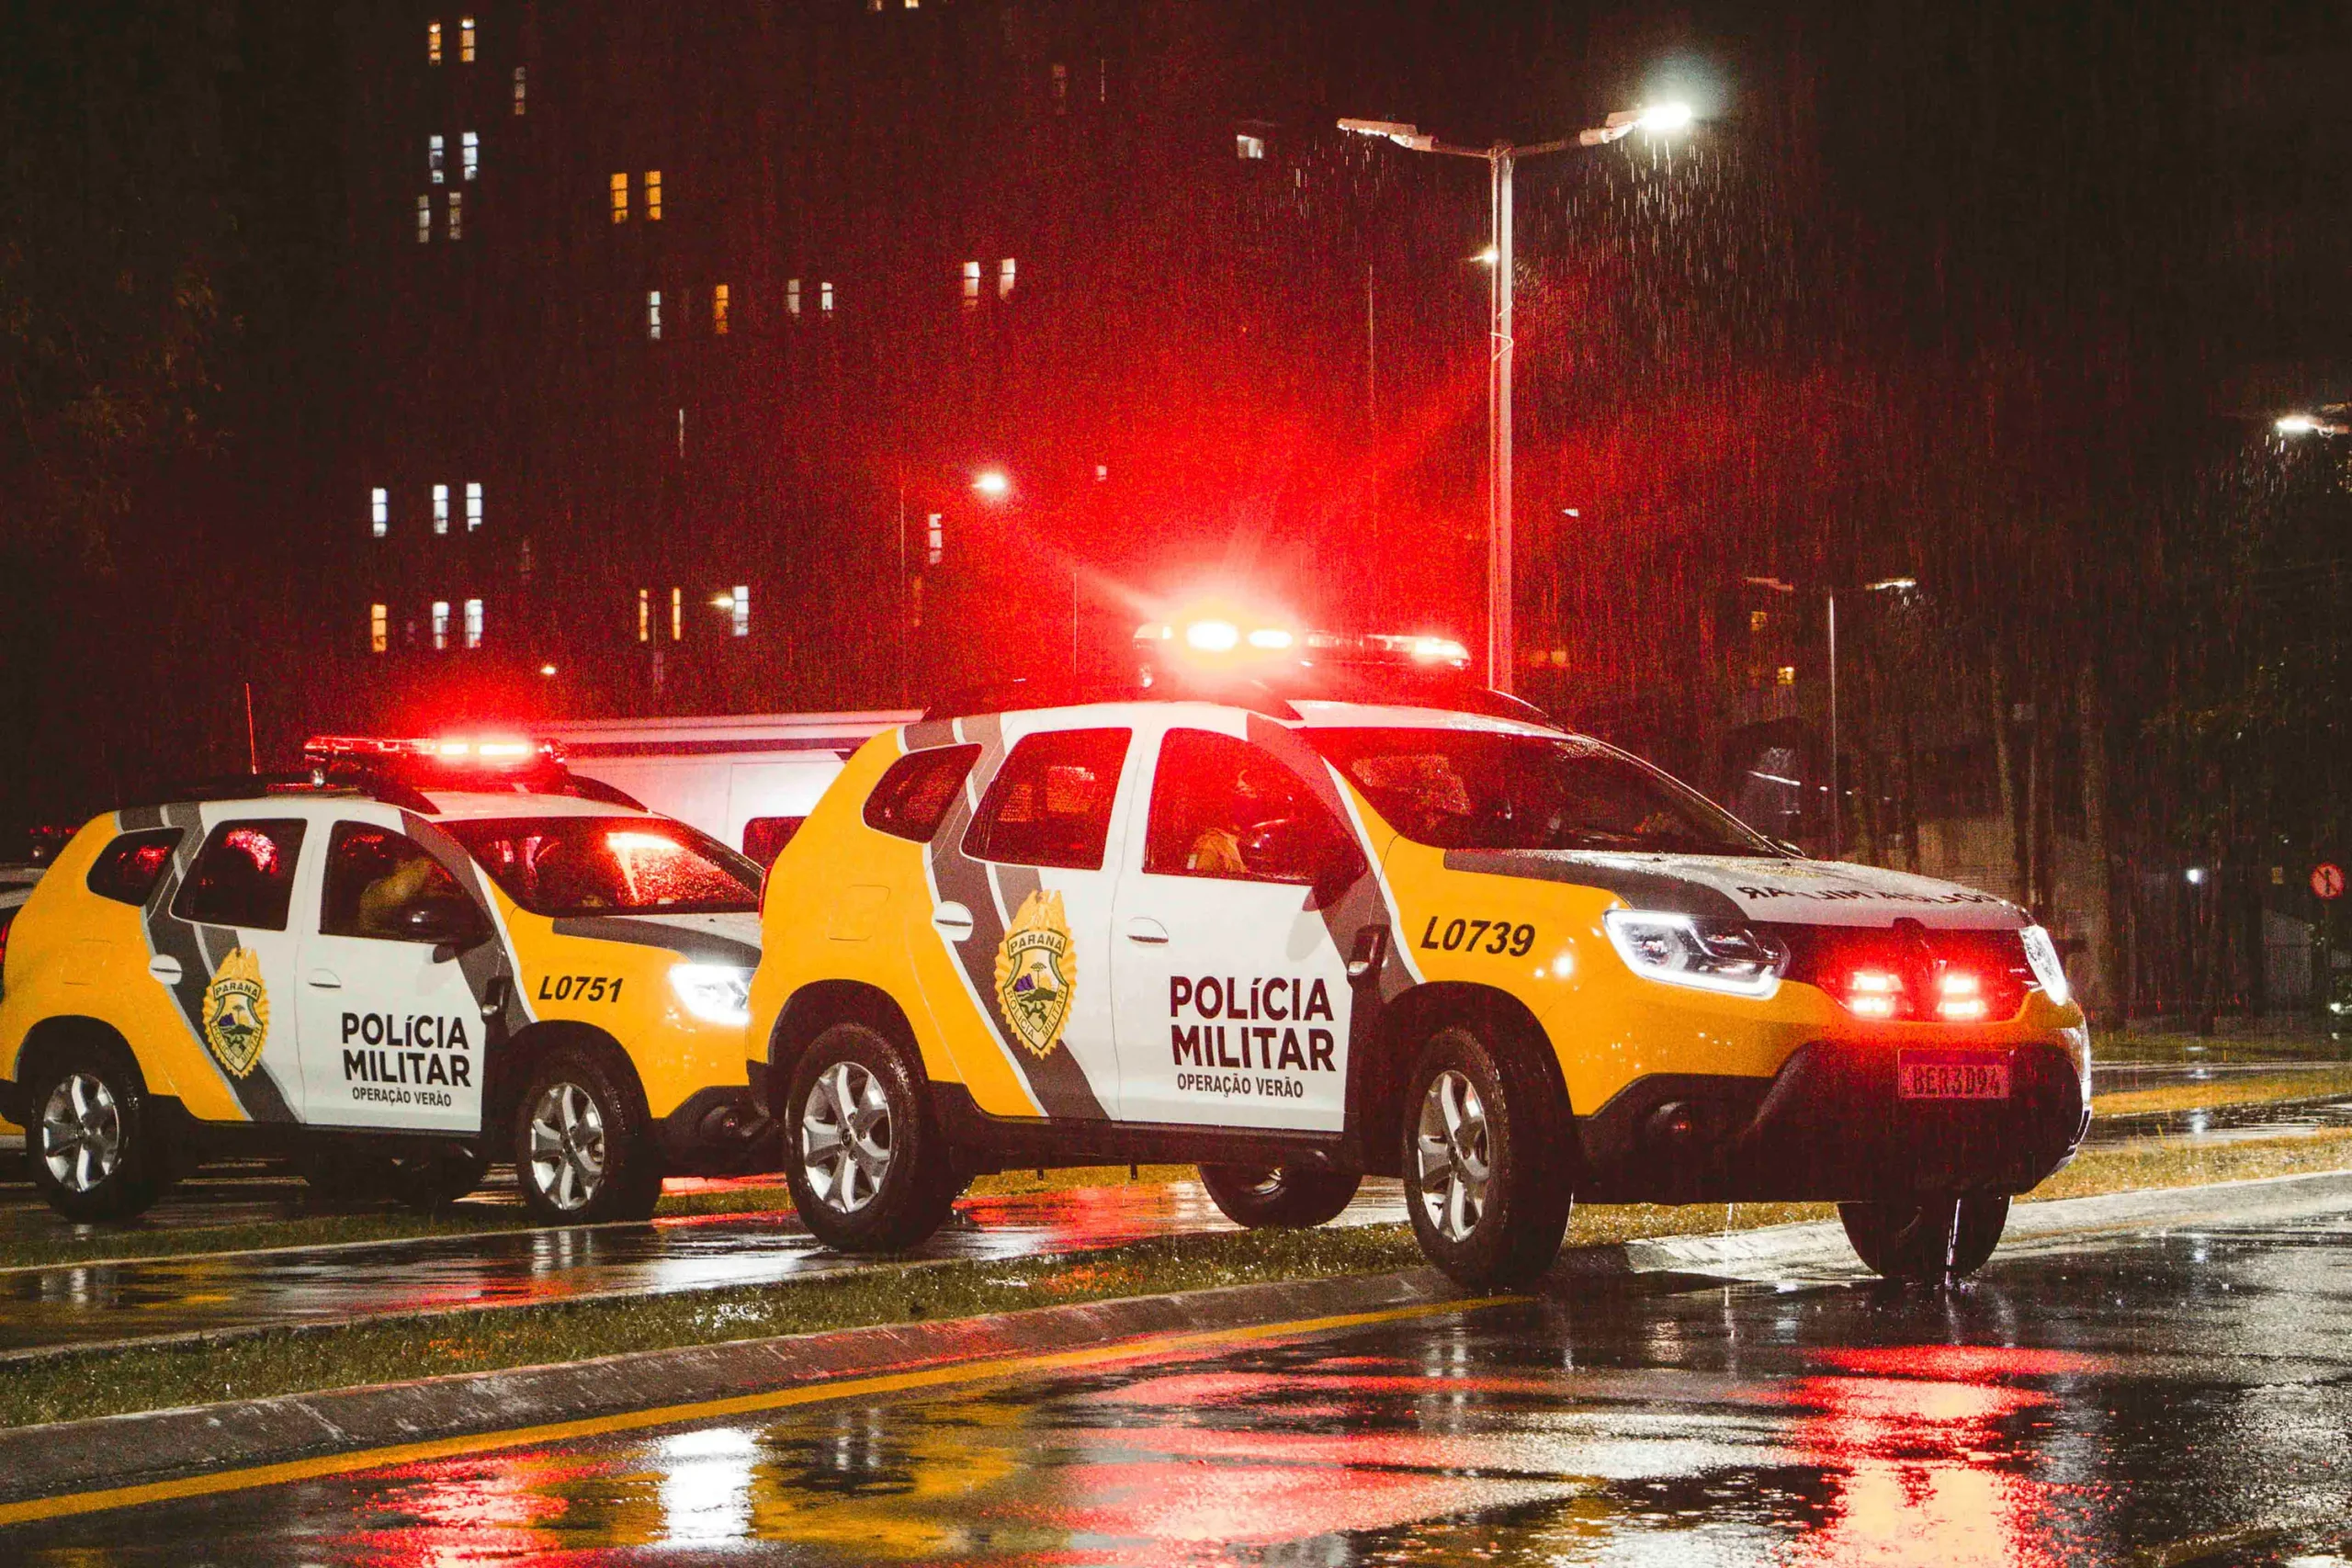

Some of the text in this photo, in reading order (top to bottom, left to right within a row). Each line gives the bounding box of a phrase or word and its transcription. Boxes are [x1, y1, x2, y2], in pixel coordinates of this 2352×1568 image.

[1010, 933, 1064, 953] PARANÁ
[1420, 916, 1535, 957] L0739
[538, 976, 624, 1003] L0751
[1170, 976, 1335, 1021] POLÍCIA
[342, 1012, 469, 1050] POLÍCIA
[1041, 988, 1066, 1039] MILITAR
[1170, 1024, 1336, 1072] MILITAR
[343, 1049, 471, 1088] MILITAR
[1177, 1073, 1304, 1099] OPERAÇÃO VERÃO
[352, 1087, 451, 1107] OPERAÇÃO VERÃO
